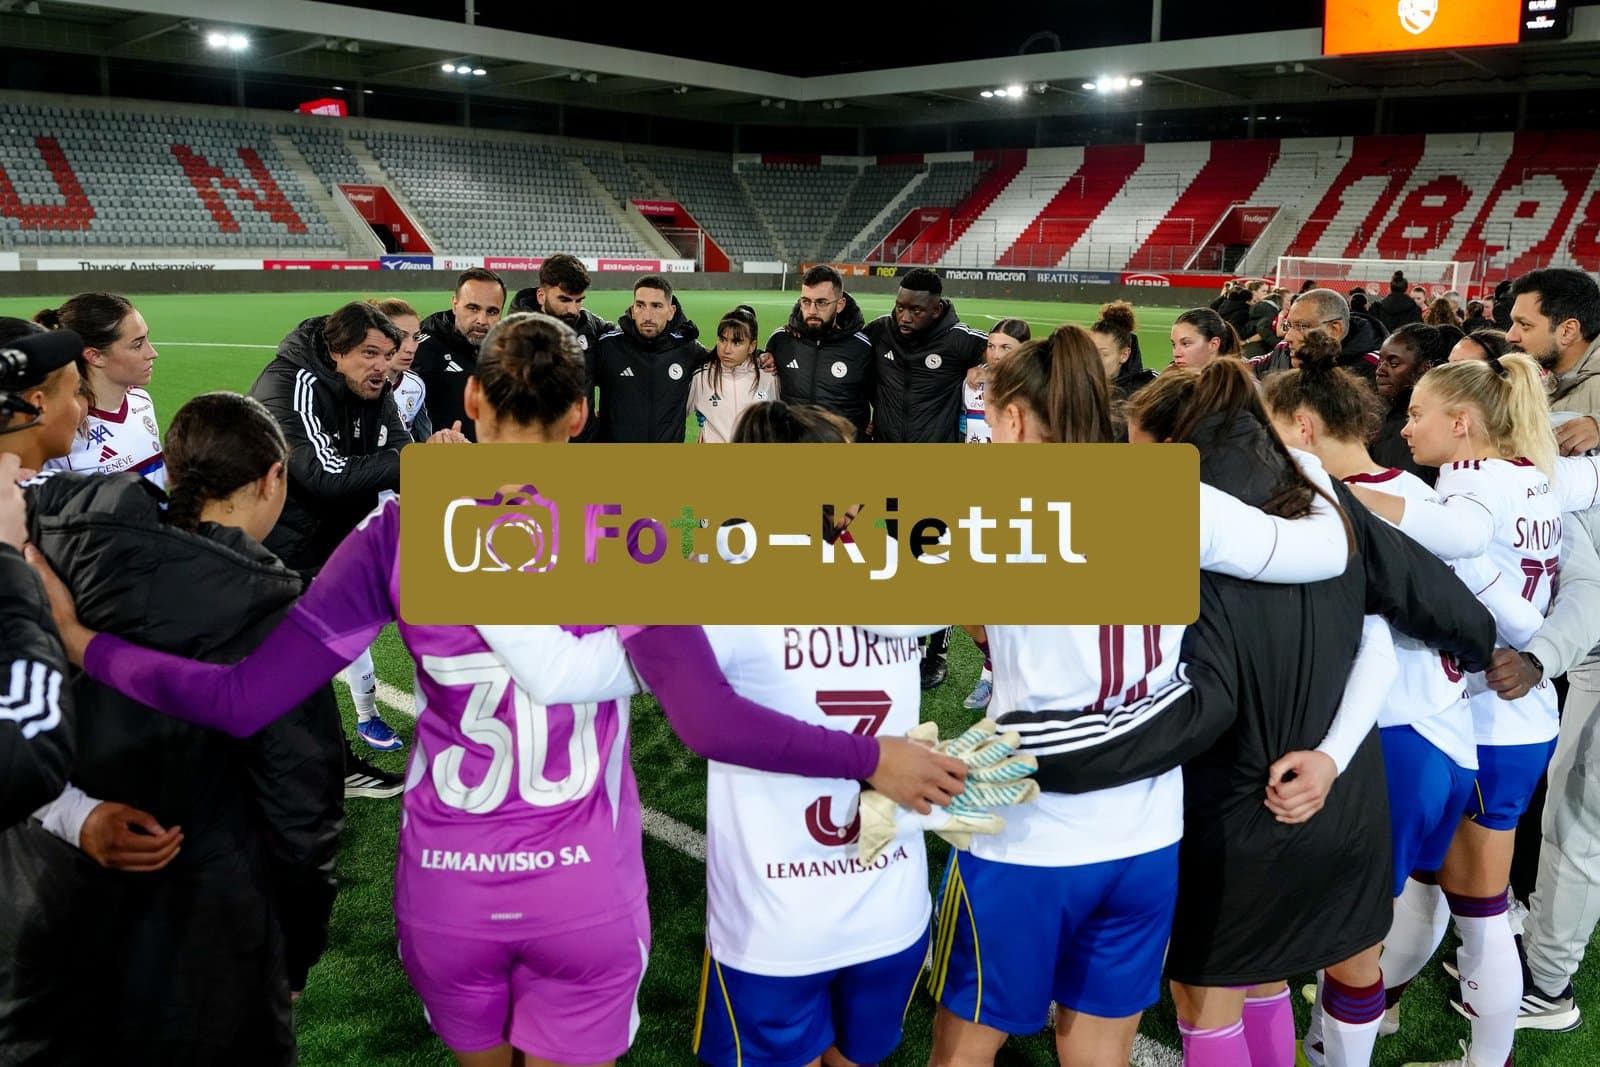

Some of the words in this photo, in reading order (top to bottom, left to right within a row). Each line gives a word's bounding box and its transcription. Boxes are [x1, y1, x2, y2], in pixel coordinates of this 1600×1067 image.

[79, 261, 126, 271] Thuner
[130, 261, 216, 271] Amtsanzeiger
[508, 262, 527, 270] Family
[618, 263, 635, 271] Family
[946, 270, 983, 281] macron
[986, 271, 1026, 282] macron
[1037, 273, 1078, 283] BEATUS
[421, 651, 600, 814] 30
[421, 850, 554, 872] LEMANVISIO
[559, 845, 591, 866] SA
[767, 854, 888, 879] LEMANVISO
